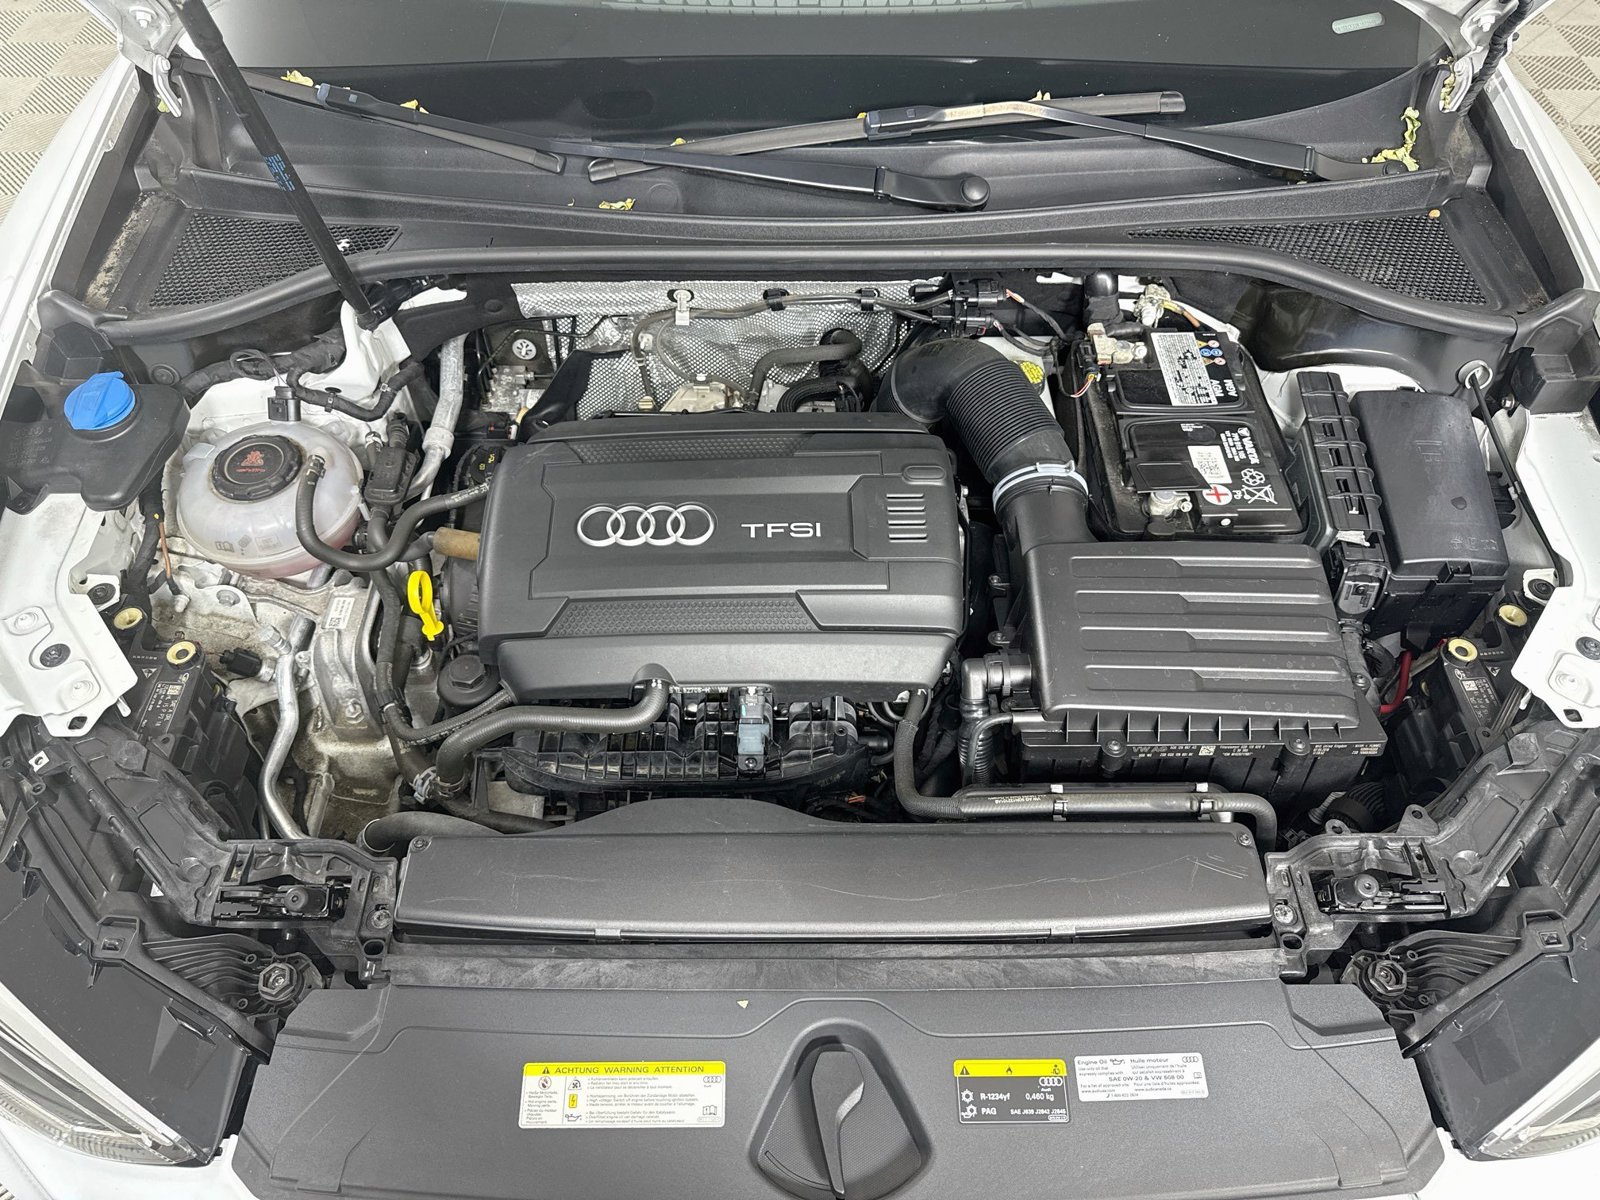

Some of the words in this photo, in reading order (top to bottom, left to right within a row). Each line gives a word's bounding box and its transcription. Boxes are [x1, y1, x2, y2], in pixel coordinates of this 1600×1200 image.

[1210, 380, 1224, 397] AGM
[1223, 378, 1239, 397] AGM
[1241, 436, 1260, 465] VARTA
[1232, 489, 1242, 499] Pb
[741, 522, 821, 538] TFSI
[980, 1092, 1010, 1101] R-1234yf
[1046, 1092, 1054, 1101] kg
